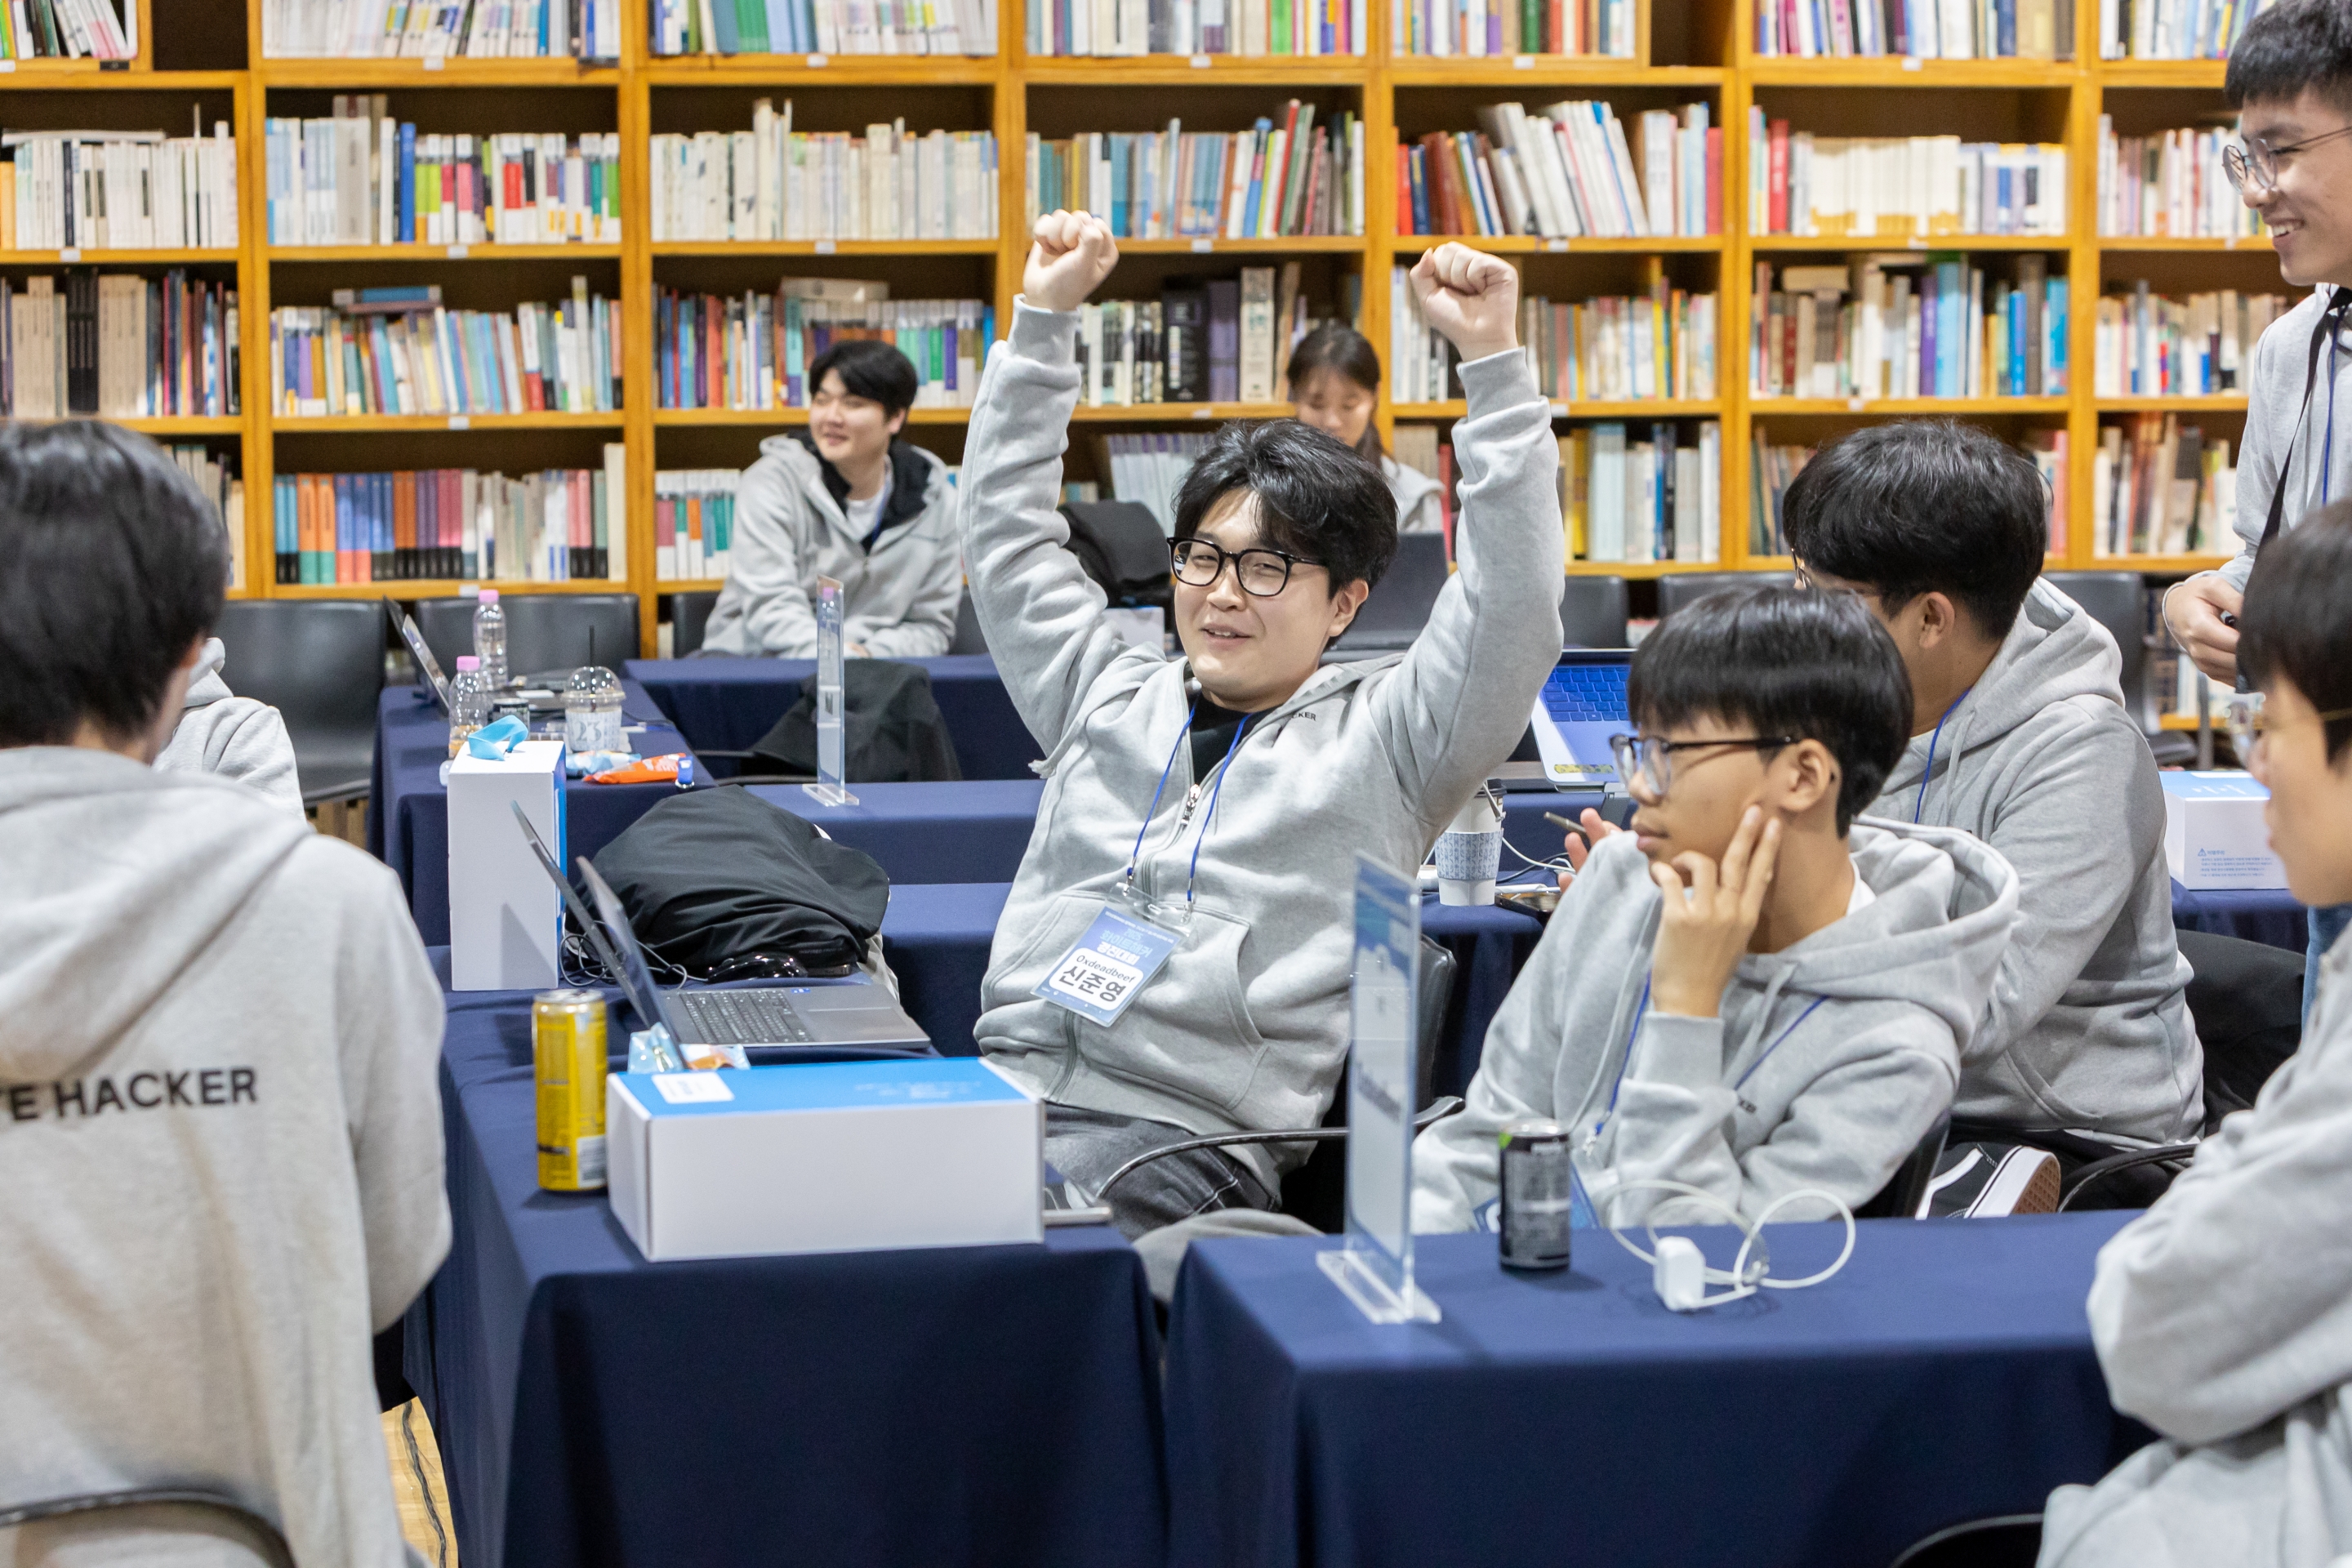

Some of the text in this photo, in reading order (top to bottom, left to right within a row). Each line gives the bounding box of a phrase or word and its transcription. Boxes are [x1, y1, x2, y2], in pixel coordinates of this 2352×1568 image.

[575, 720, 603, 742] 23
[1097, 941, 1141, 965] 경진대회
[1100, 929, 1154, 958] 화이트해커
[1058, 964, 1127, 1003] 신준영
[52, 1065, 258, 1119] HACKER
